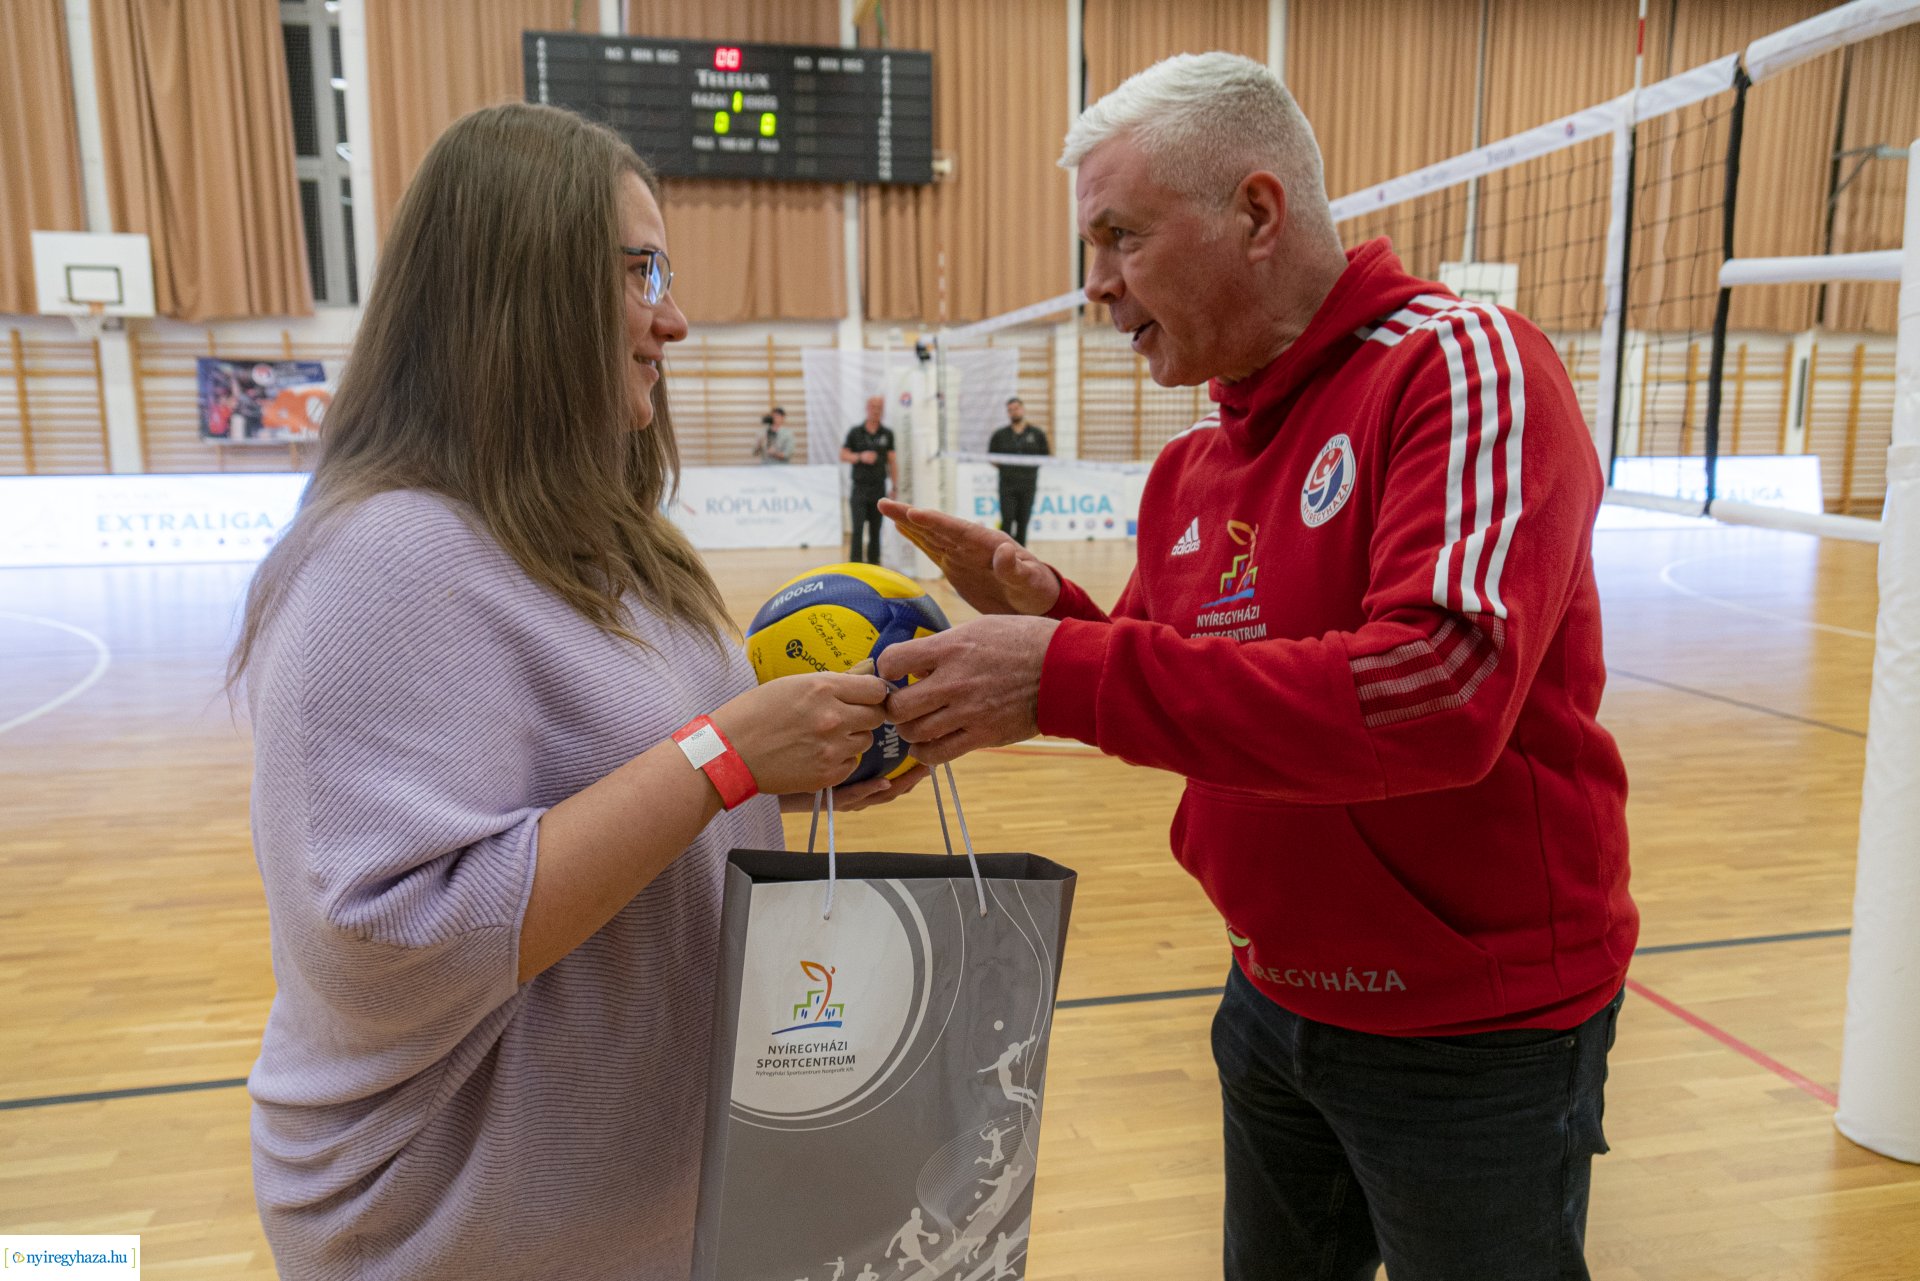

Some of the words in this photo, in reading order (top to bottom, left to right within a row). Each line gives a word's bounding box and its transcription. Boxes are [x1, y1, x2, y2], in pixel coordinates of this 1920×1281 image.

[706, 495, 813, 514] RÖPLABDA
[974, 495, 1113, 516] EXALIGA
[97, 511, 274, 533] EXTRALIGA
[1171, 539, 1200, 556] adidas
[771, 581, 824, 610] V200W
[1197, 604, 1260, 628] NYÍREGYHÁZI
[767, 1040, 848, 1055] NYÍREGYHÁZI
[756, 1055, 856, 1069] SPORTCENTRUM
